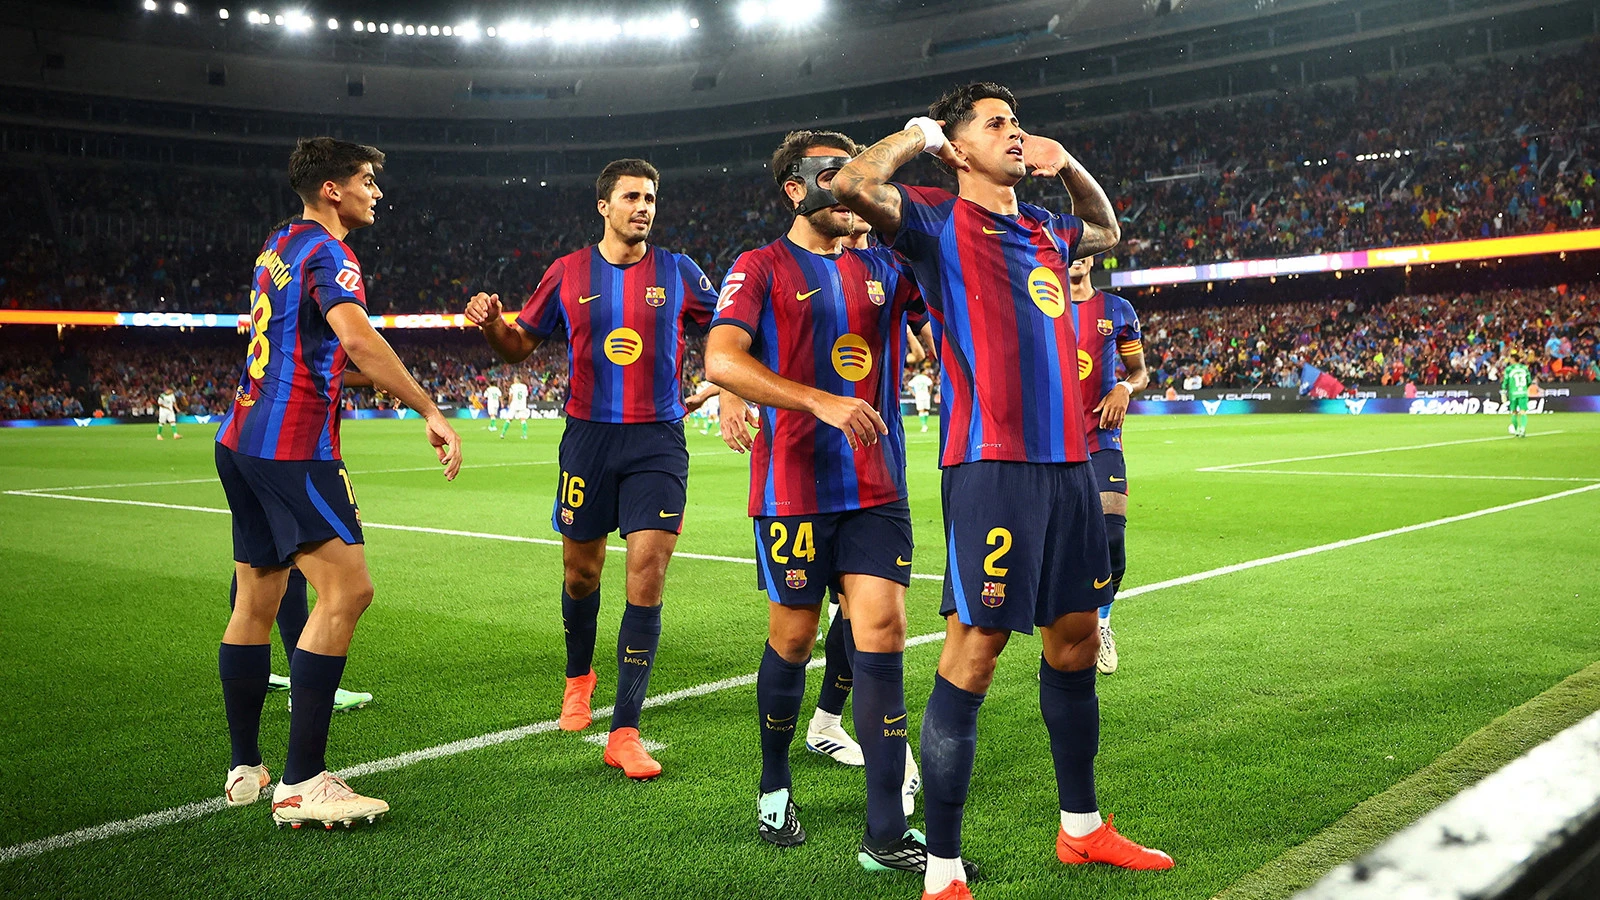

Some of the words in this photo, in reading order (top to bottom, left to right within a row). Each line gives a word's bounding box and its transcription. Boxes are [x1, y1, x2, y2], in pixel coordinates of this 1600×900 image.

[247, 290, 272, 379] 8
[1409, 397, 1481, 414] BEYOND
[561, 470, 586, 508] 16
[769, 521, 816, 565] 24
[983, 527, 1013, 577] 2
[623, 656, 648, 667] BARÇA
